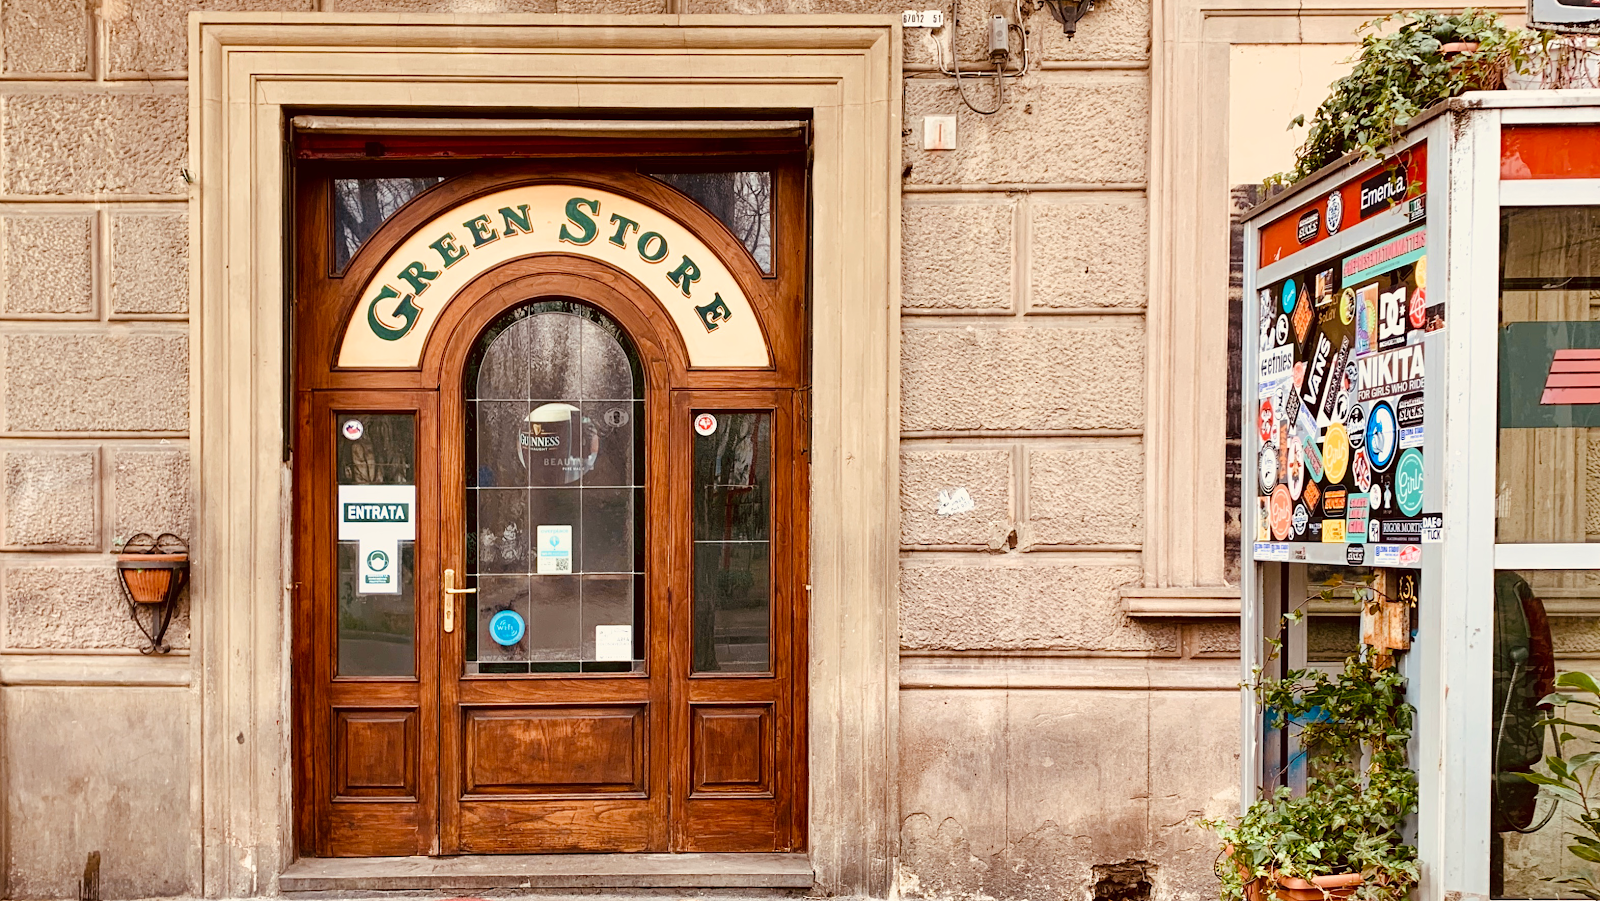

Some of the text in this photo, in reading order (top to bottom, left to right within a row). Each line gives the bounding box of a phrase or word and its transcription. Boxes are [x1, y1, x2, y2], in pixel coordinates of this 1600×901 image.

[933, 14, 941, 23] 51
[1304, 332, 1331, 405] VANS
[1358, 344, 1425, 391] NIKITA
[1358, 389, 1371, 400] FOR
[1371, 385, 1391, 398] GIRLS
[1391, 381, 1408, 394] WHO
[521, 434, 560, 446] GUNNESS
[348, 506, 405, 519] ENTRATA
[1383, 523, 1400, 533] RIGOR
